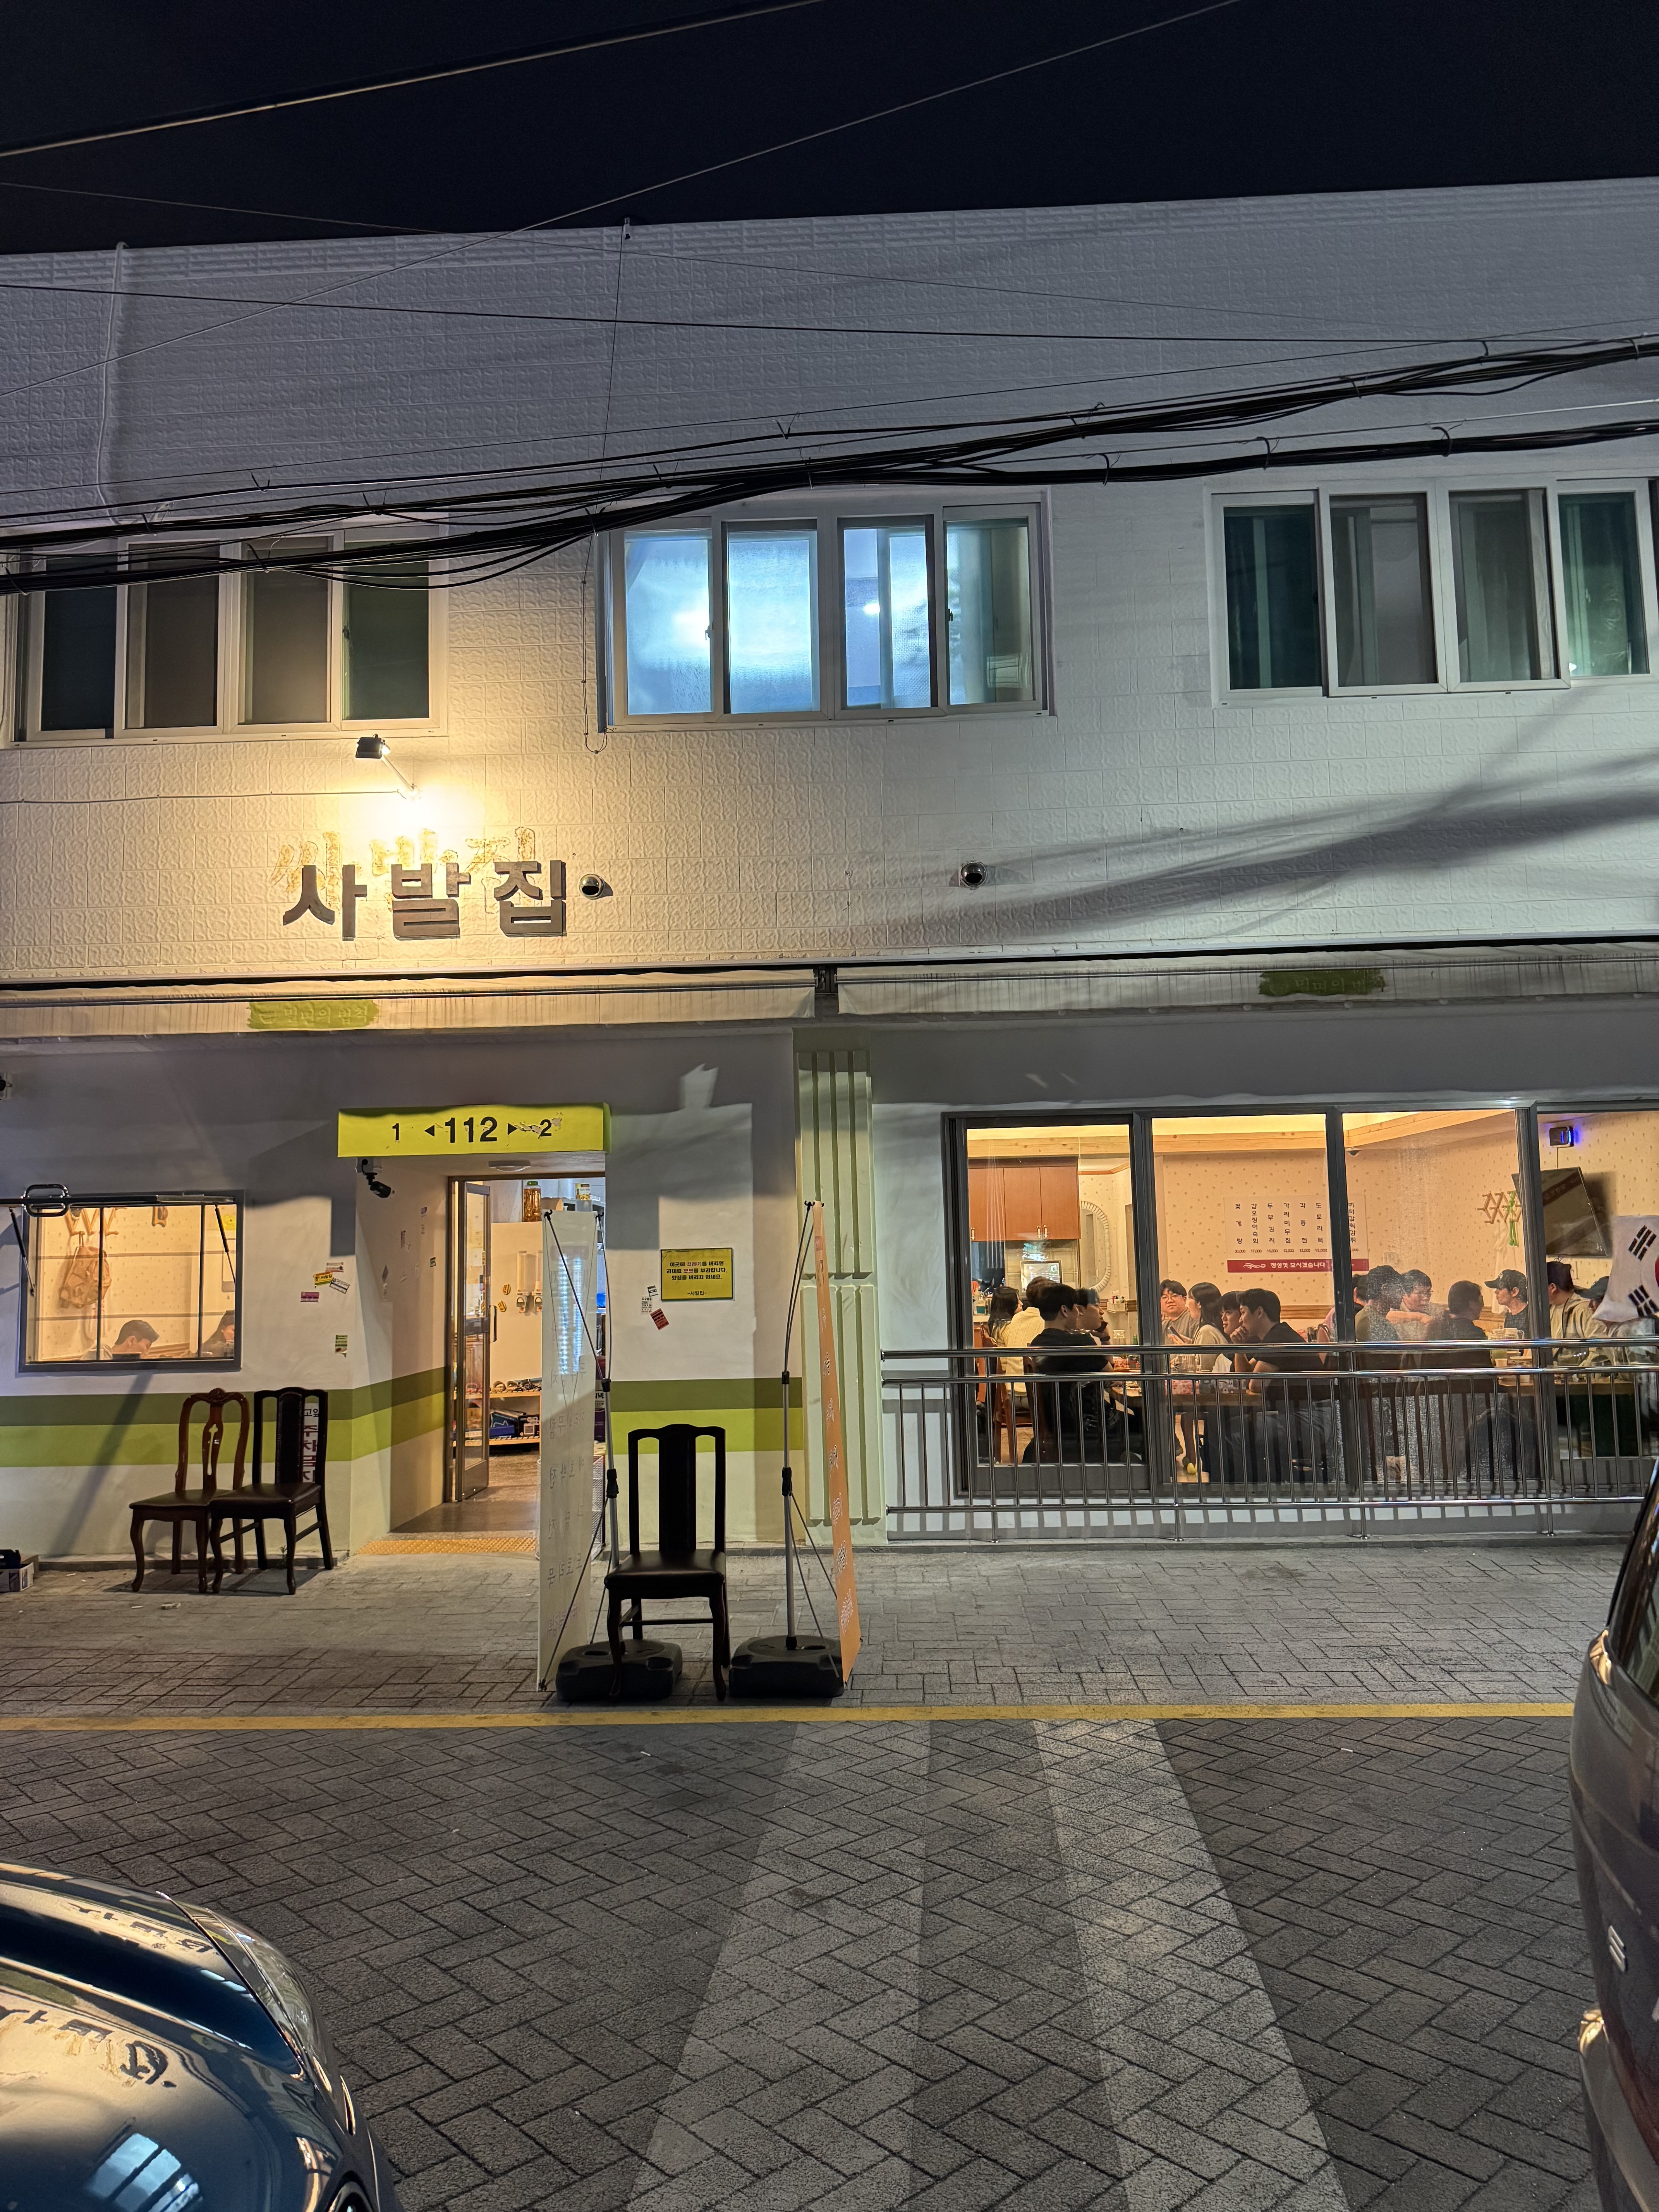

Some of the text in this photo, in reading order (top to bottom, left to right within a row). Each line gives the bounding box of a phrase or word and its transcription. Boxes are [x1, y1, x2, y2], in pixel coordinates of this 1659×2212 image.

[283, 860, 567, 941] 사발집
[283, 1005, 368, 1026] 밀면의 법칙
[392, 1116, 552, 1143] 1 112 2
